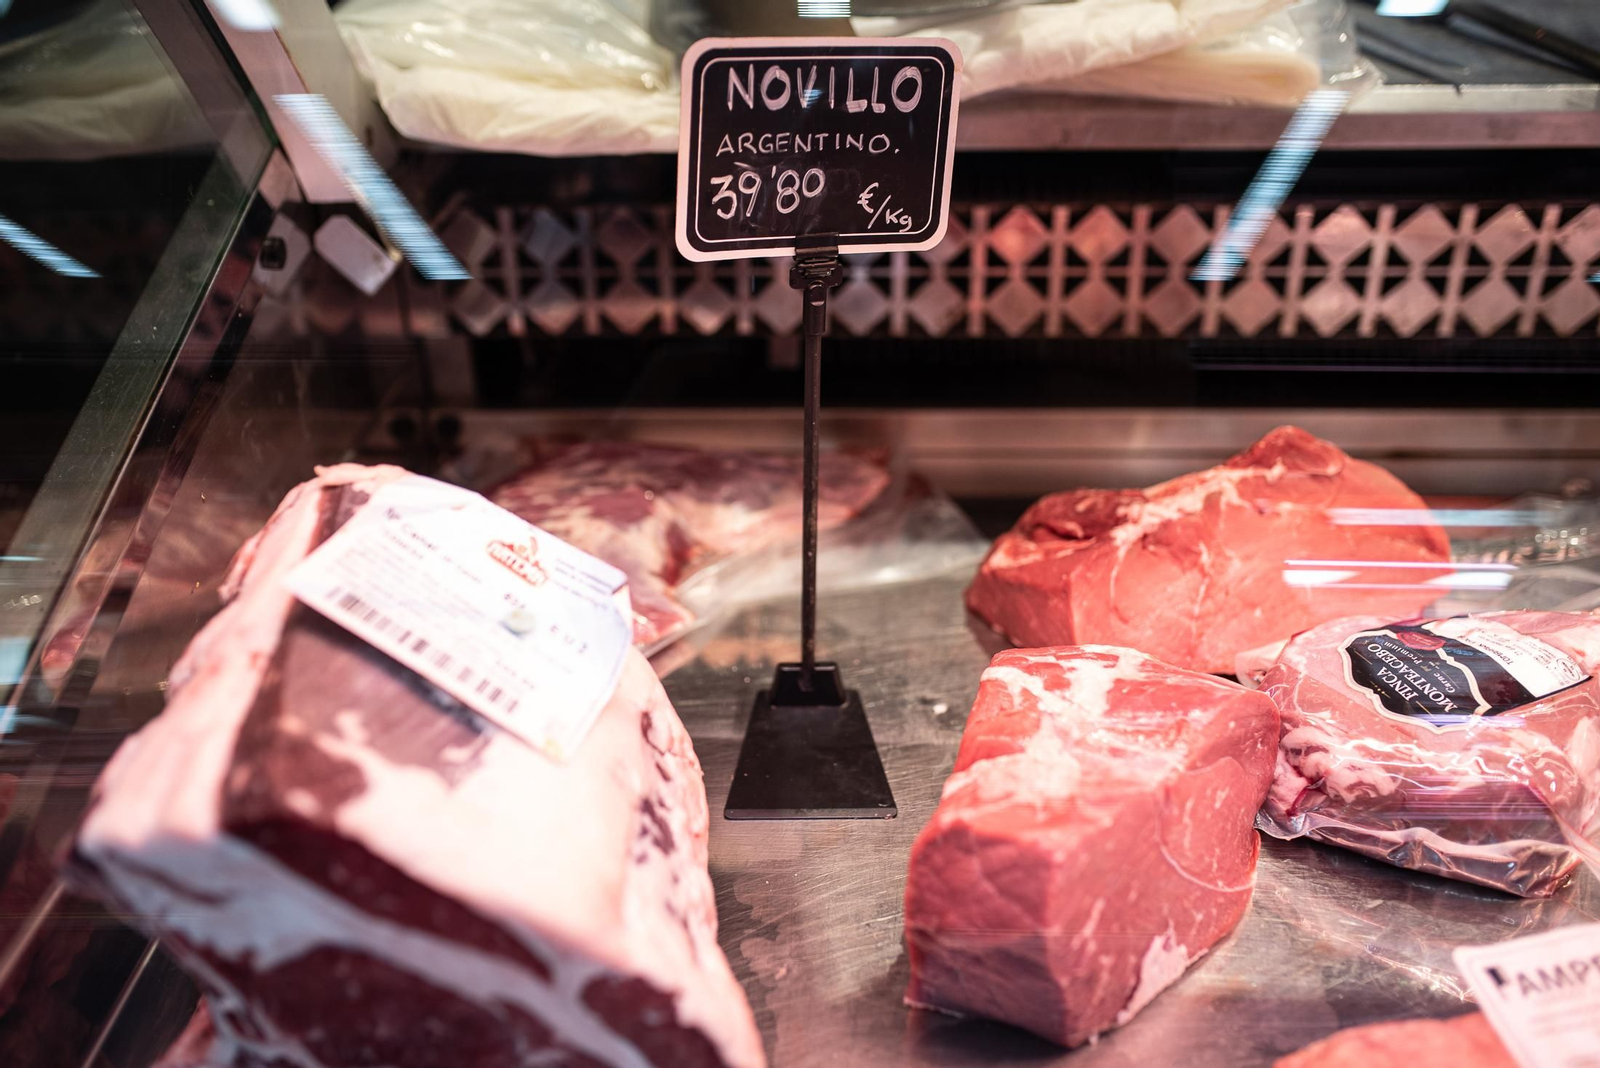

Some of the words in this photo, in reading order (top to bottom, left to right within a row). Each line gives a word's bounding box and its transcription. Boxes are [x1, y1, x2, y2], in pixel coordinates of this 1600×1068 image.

[727, 64, 923, 113] NOVILLO
[716, 132, 899, 157] ARGENTINO.
[710, 166, 826, 219] 39'80
[1384, 641, 1423, 666] Premium
[1367, 642, 1458, 714] MONTEACEBO
[1376, 666, 1419, 702] FINCA
[1432, 672, 1457, 694] Carne
